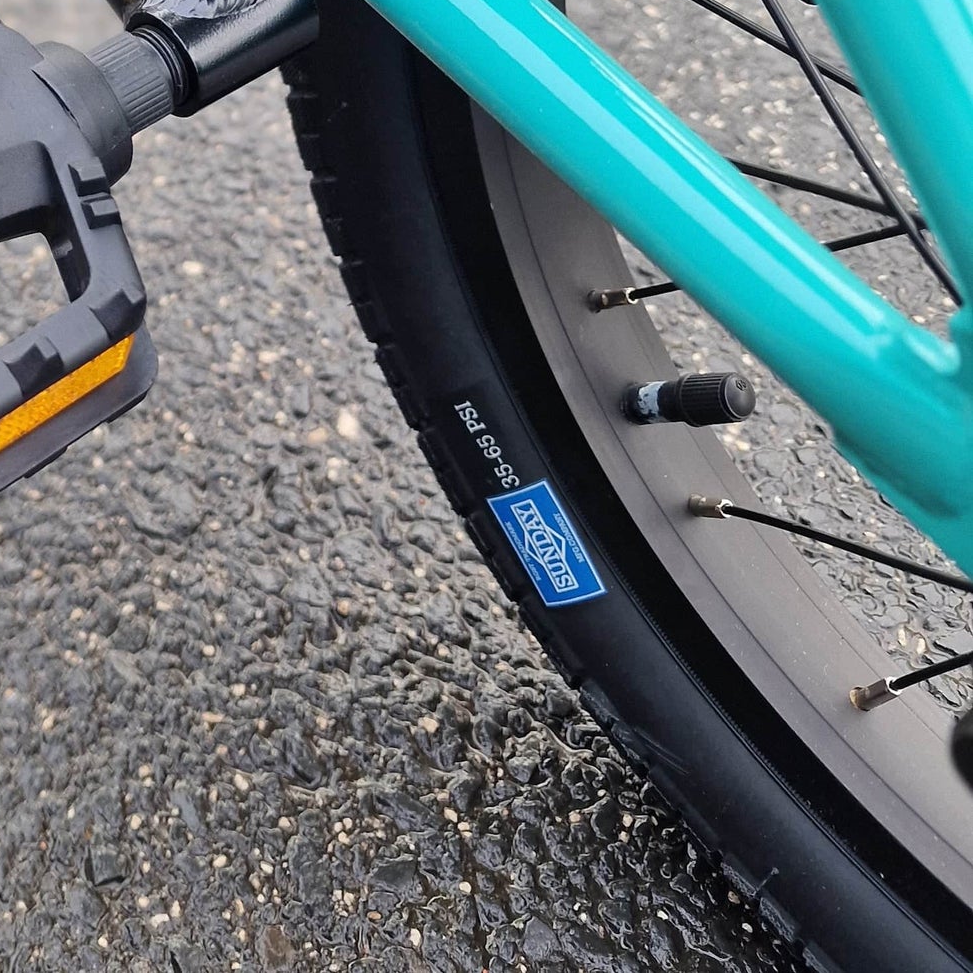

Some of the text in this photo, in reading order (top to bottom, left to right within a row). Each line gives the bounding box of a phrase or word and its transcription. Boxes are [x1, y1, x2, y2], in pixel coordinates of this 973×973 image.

[454, 400, 521, 490] 35-65 PSI
[516, 506, 574, 588] SUNDAY
